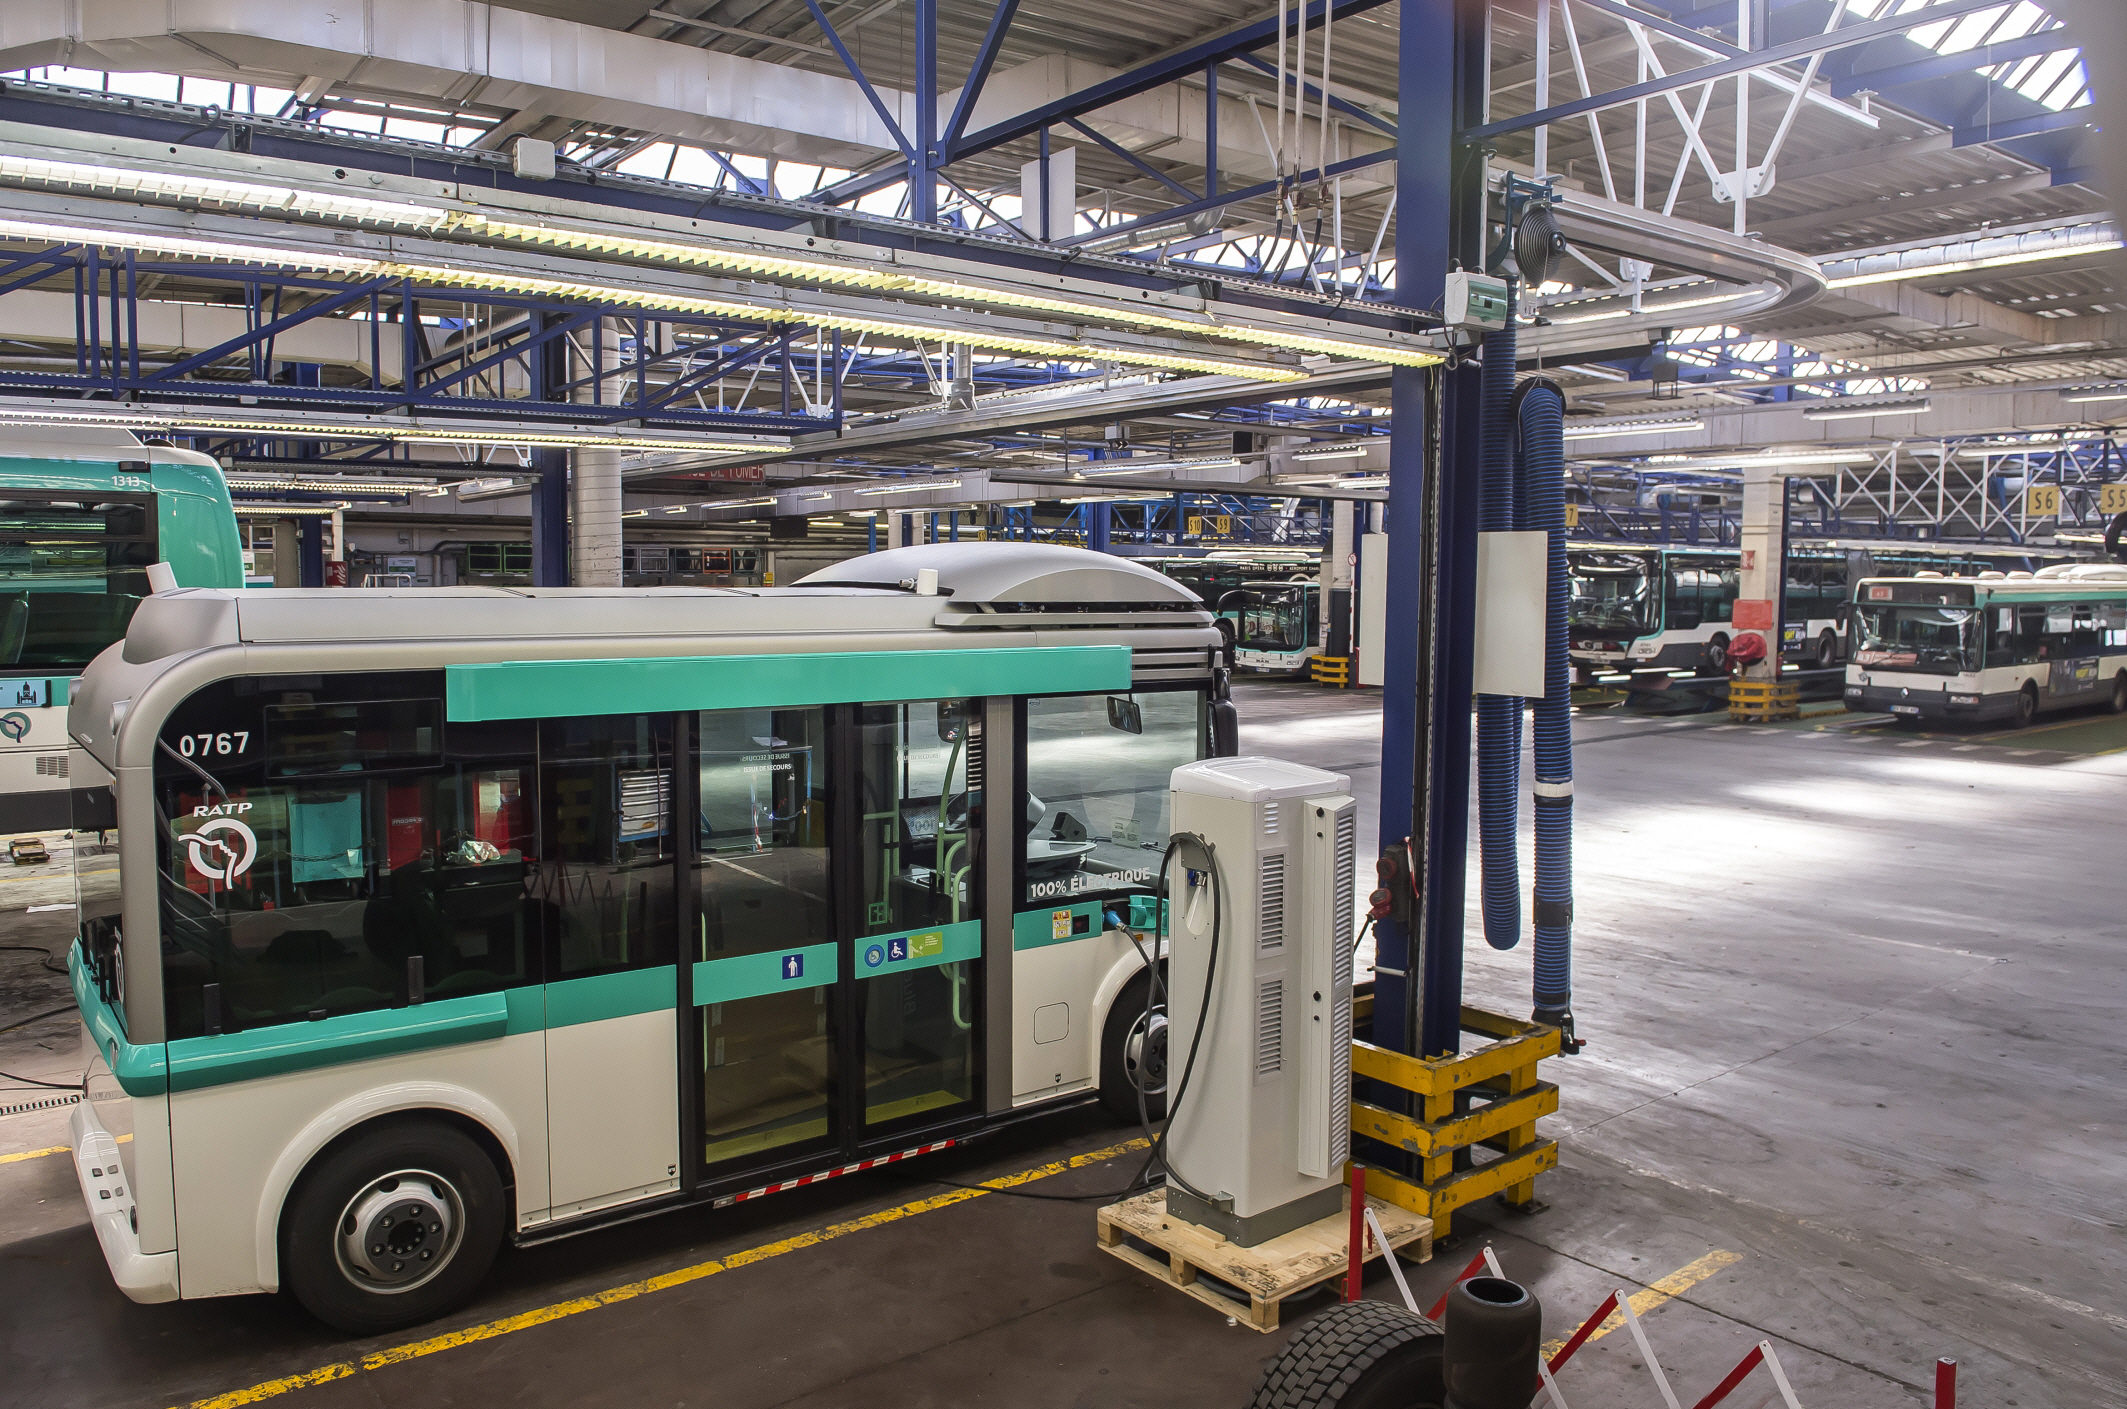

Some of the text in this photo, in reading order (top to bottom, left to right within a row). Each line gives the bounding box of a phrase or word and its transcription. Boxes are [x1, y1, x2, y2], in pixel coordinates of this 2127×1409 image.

[111, 475, 140, 487] 1313
[179, 731, 250, 757] 0767
[193, 802, 253, 818] RATP
[1031, 879, 1067, 898] 100%
